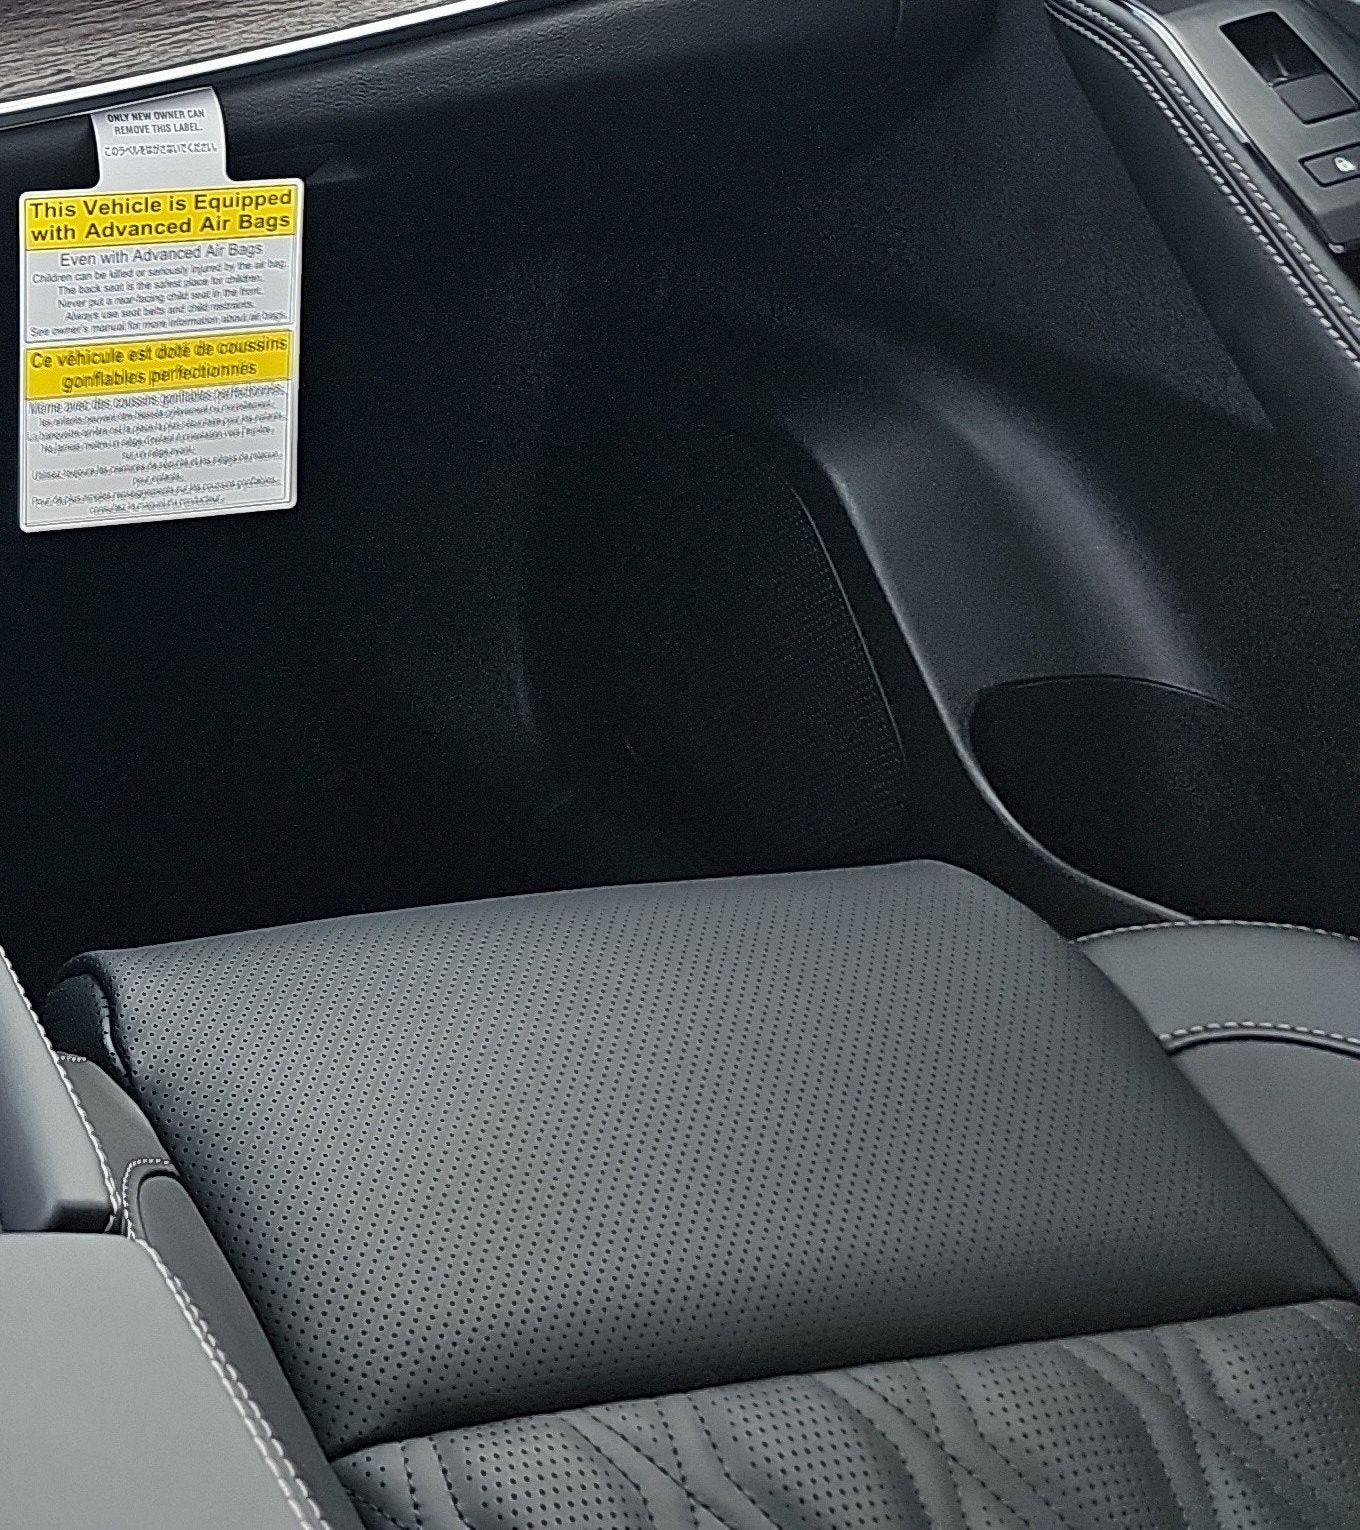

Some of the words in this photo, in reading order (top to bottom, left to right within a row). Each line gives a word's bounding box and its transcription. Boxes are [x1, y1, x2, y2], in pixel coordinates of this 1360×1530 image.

[107, 114, 129, 122] ONLY
[132, 112, 151, 121] NEW
[154, 110, 185, 120] OWNER
[188, 109, 205, 117] CAN
[114, 124, 150, 135] REMOVE
[151, 124, 171, 133] THIS
[174, 122, 203, 132] LABEL.
[30, 202, 76, 218] This
[83, 197, 161, 216] Vehicle
[170, 195, 186, 211] is
[194, 189, 292, 211] Equipped
[31, 224, 75, 241] with
[85, 217, 191, 239] Advanced
[200, 216, 231, 232] Air
[239, 213, 290, 232] Bags
[60, 254, 96, 267] Even
[100, 249, 129, 264] with
[132, 246, 201, 264] Advanced
[205, 245, 226, 258] Air
[228, 242, 263, 259] Bags
[31, 353, 53, 369] Ce
[57, 348, 124, 367] véhicule
[128, 346, 152, 362] est
[157, 342, 190, 360] doté
[195, 341, 215, 356] de
[218, 336, 287, 354] coussins
